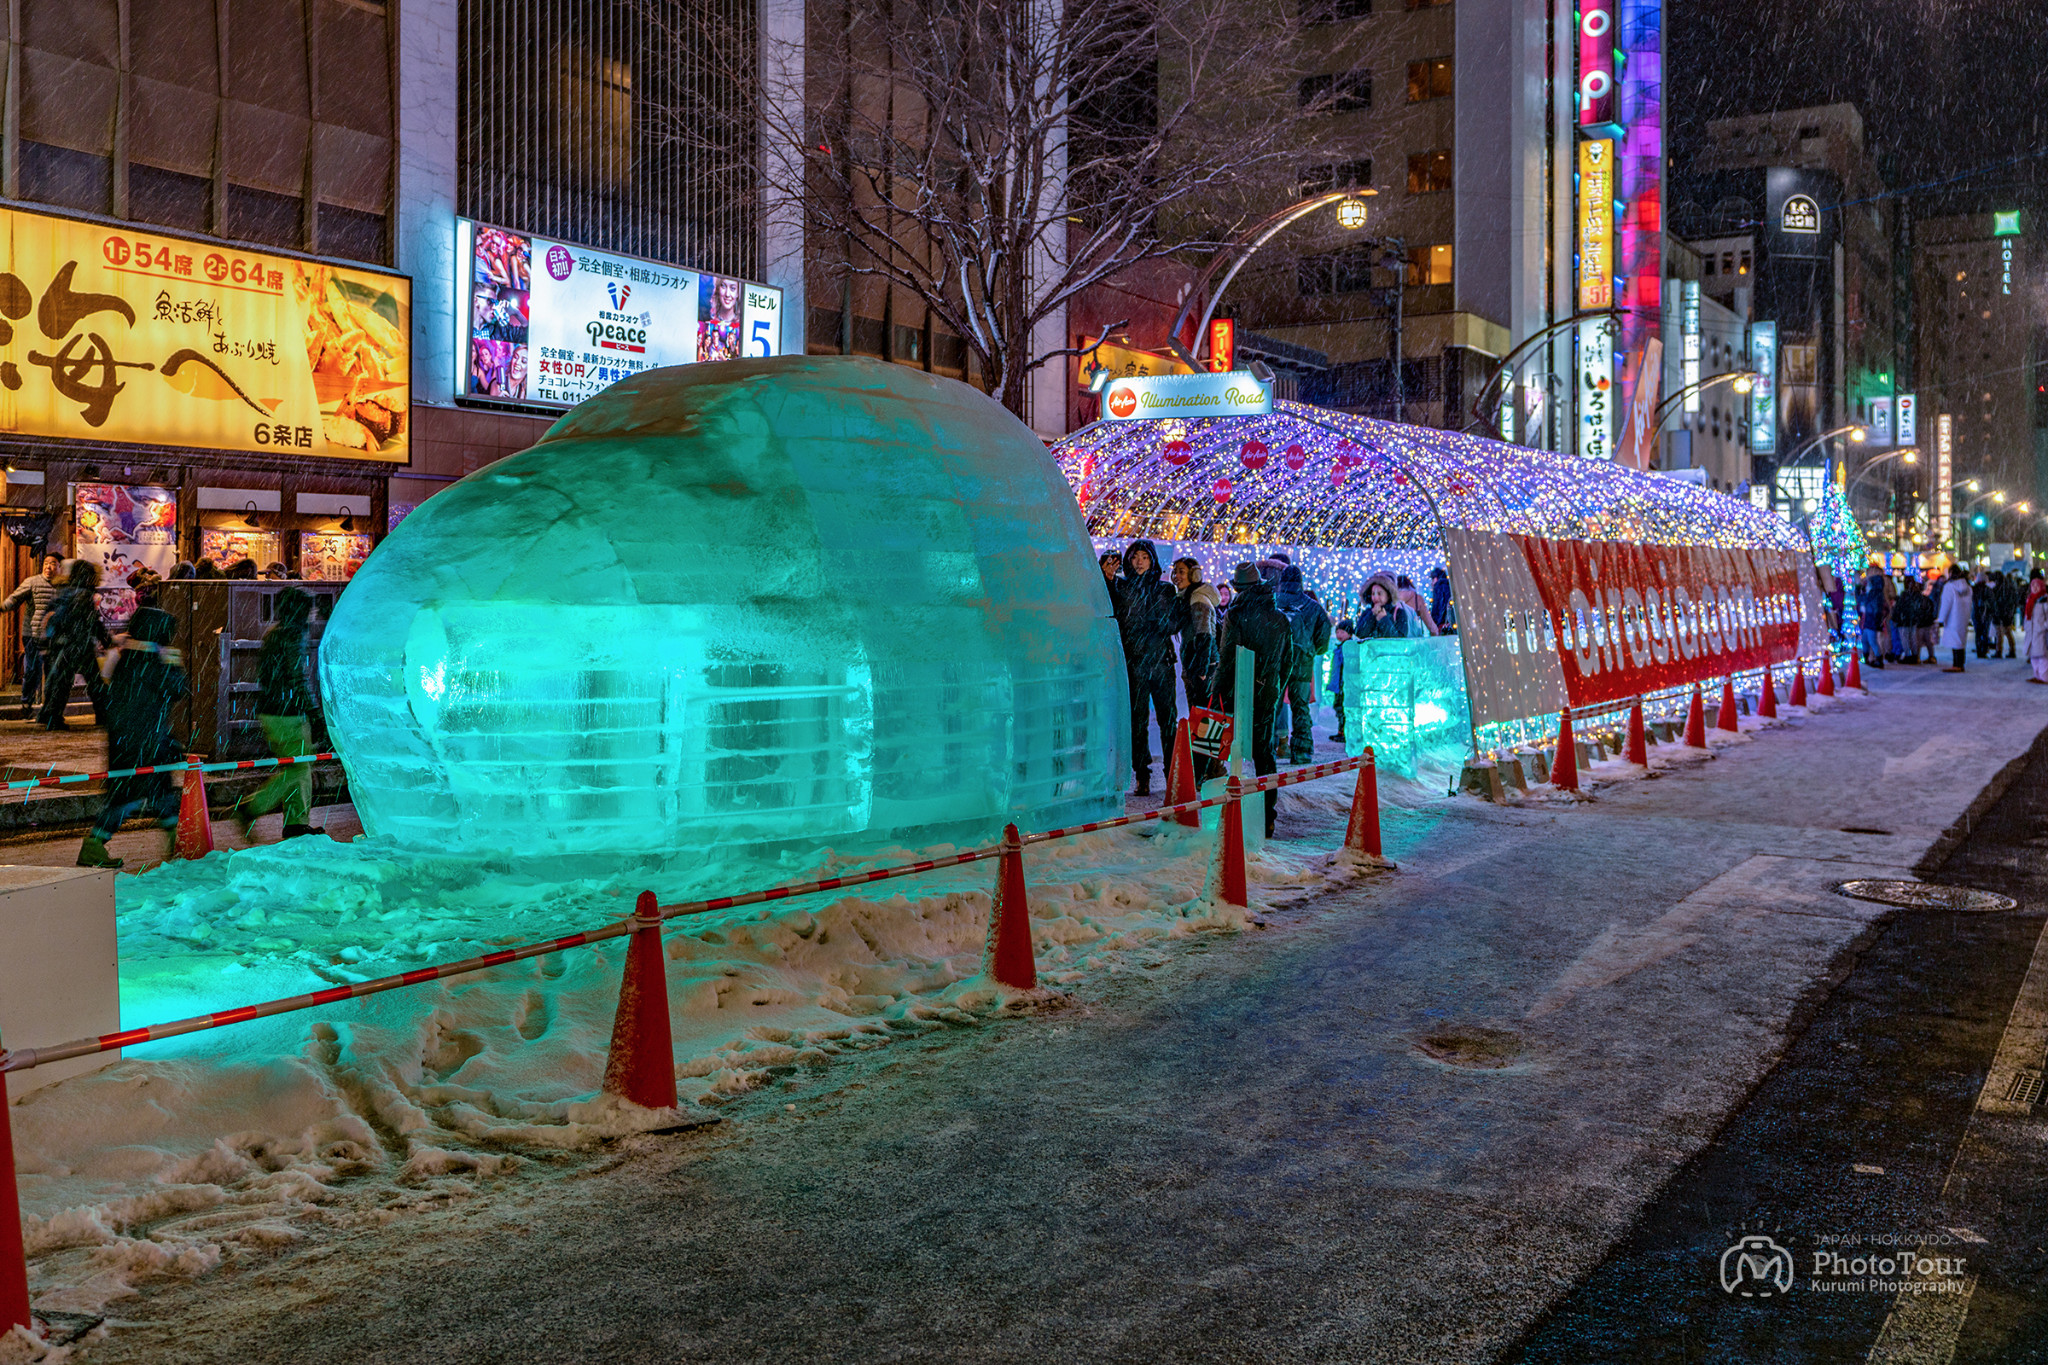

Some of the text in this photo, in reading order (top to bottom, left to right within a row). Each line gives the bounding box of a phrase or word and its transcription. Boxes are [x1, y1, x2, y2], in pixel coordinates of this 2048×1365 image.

[549, 250, 567, 263] 日本
[2001, 238, 2012, 295] HOTEL
[578, 256, 690, 291] 完全個室・相席カラオケ
[748, 292, 777, 311] 当ビル
[1590, 285, 1610, 306] 5F
[598, 310, 640, 325] 相席カラオケ
[213, 331, 280, 366] あぶり焼
[538, 387, 559, 401] TEL
[1140, 391, 1221, 409] Illumination
[1224, 386, 1266, 407] Road
[254, 422, 313, 449] 6条店
[1569, 557, 1764, 678] airasia.com
